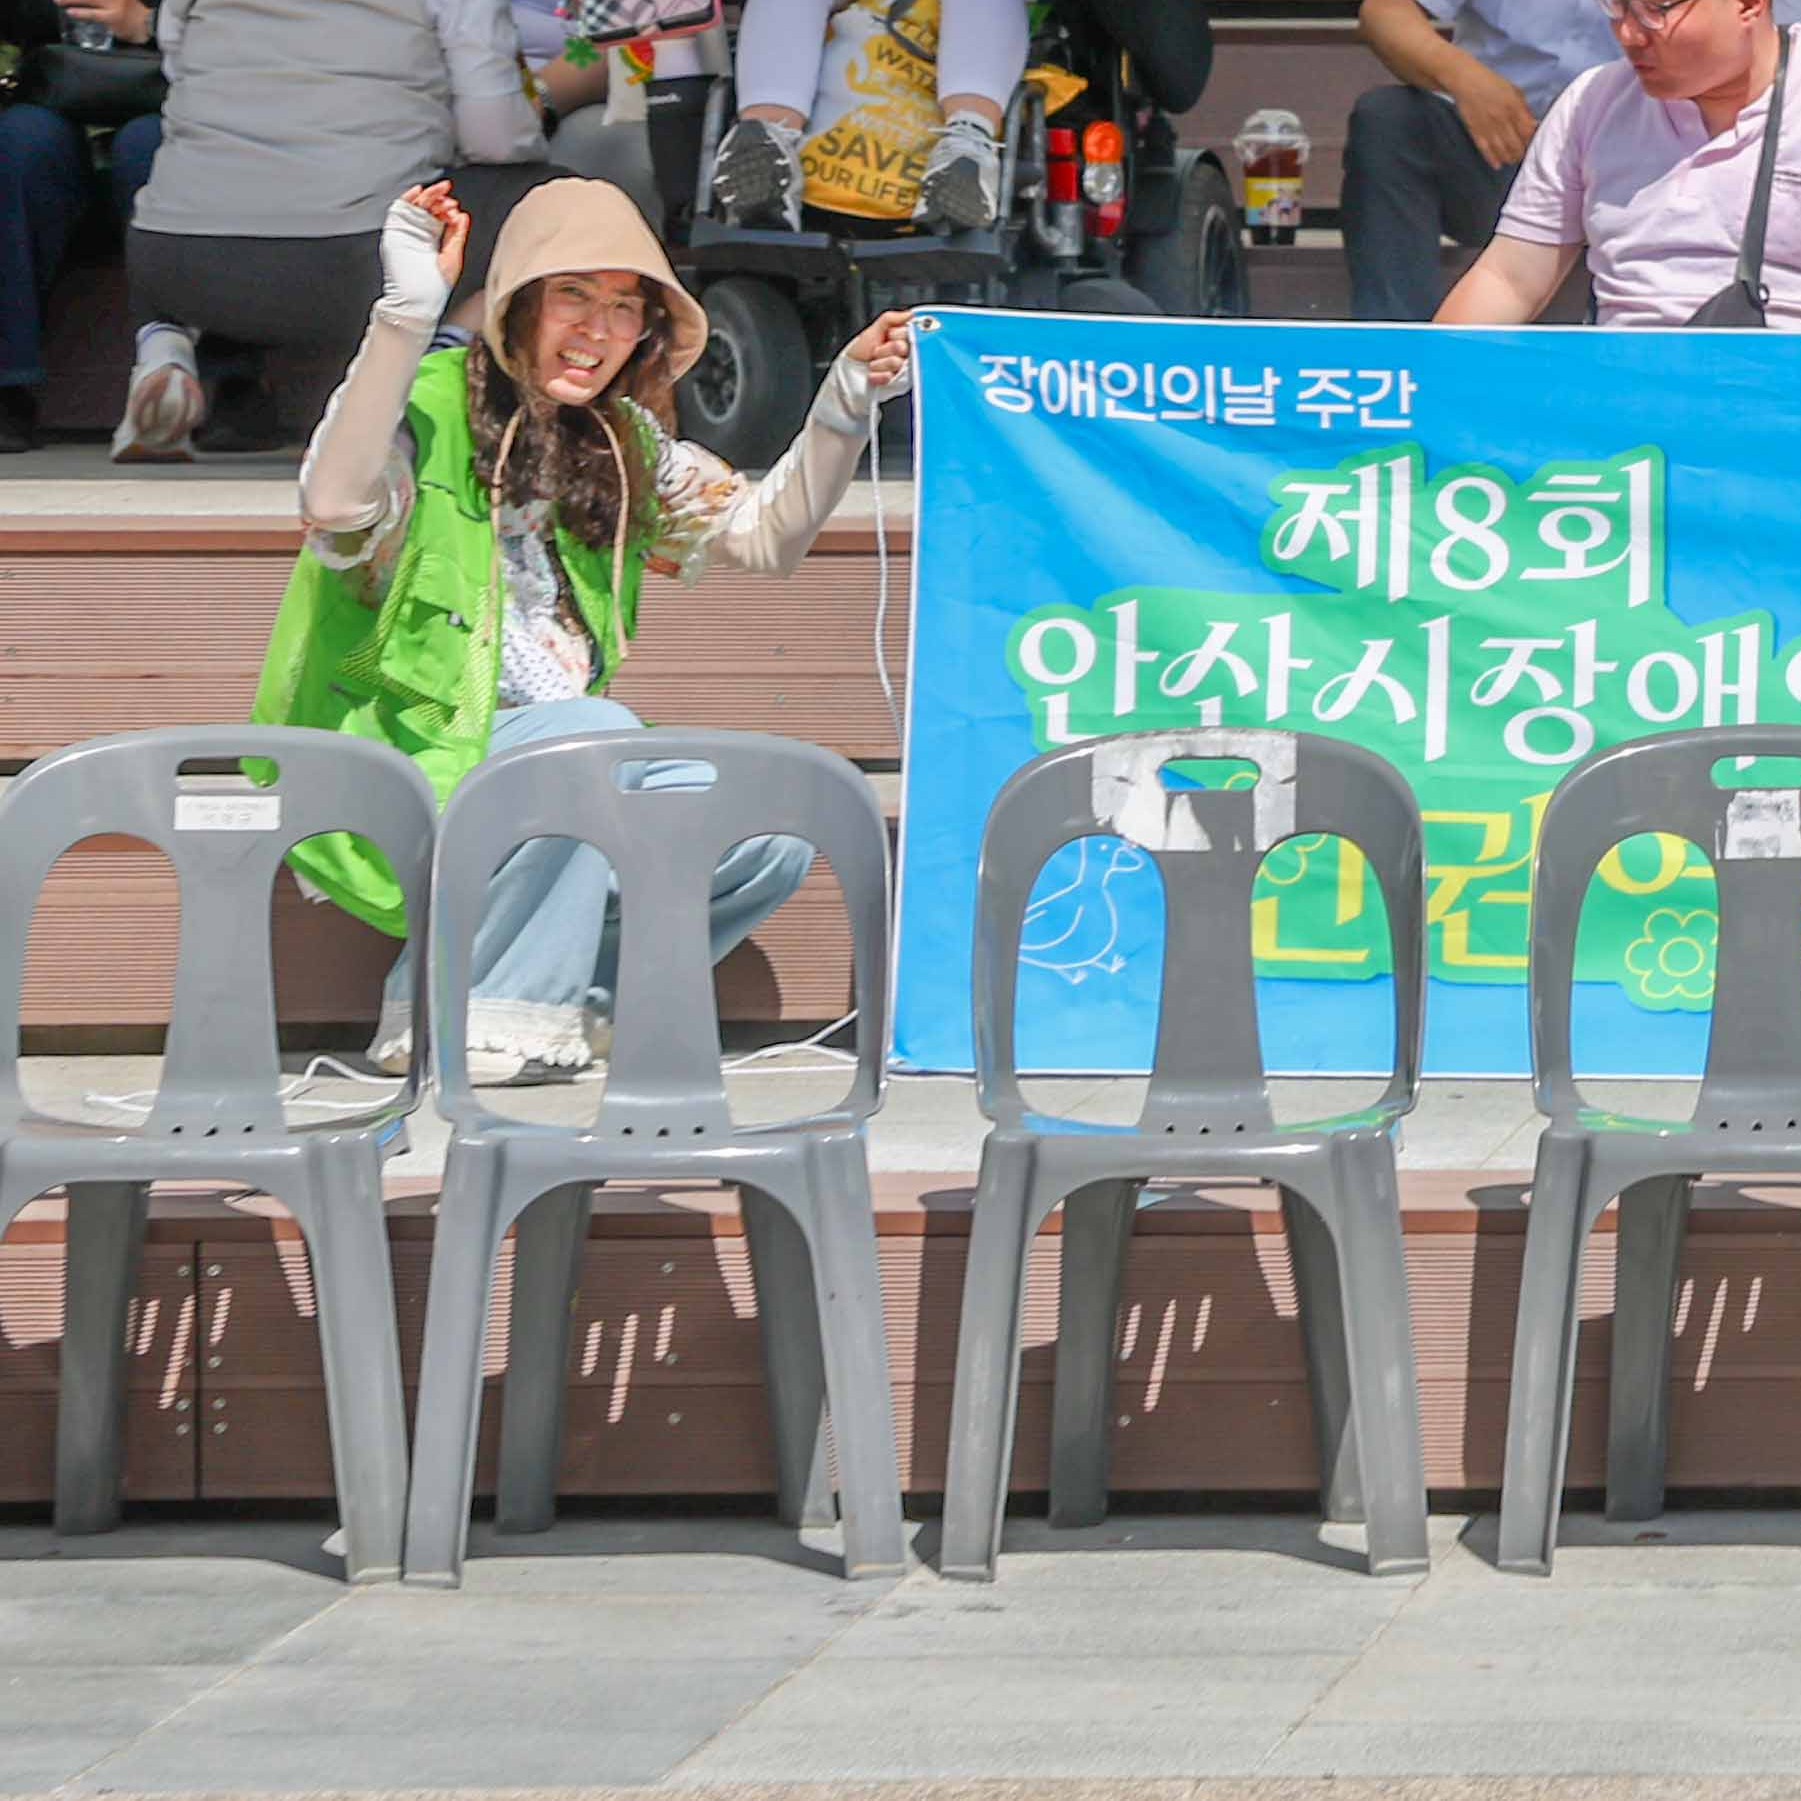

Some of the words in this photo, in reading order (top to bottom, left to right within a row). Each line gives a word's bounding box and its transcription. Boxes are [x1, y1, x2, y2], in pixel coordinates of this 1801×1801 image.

[818, 126, 928, 184] SAVE
[978, 354, 1281, 426] 장애인의날
[1297, 366, 1418, 430] 주간
[1272, 452, 1652, 611] 제8회
